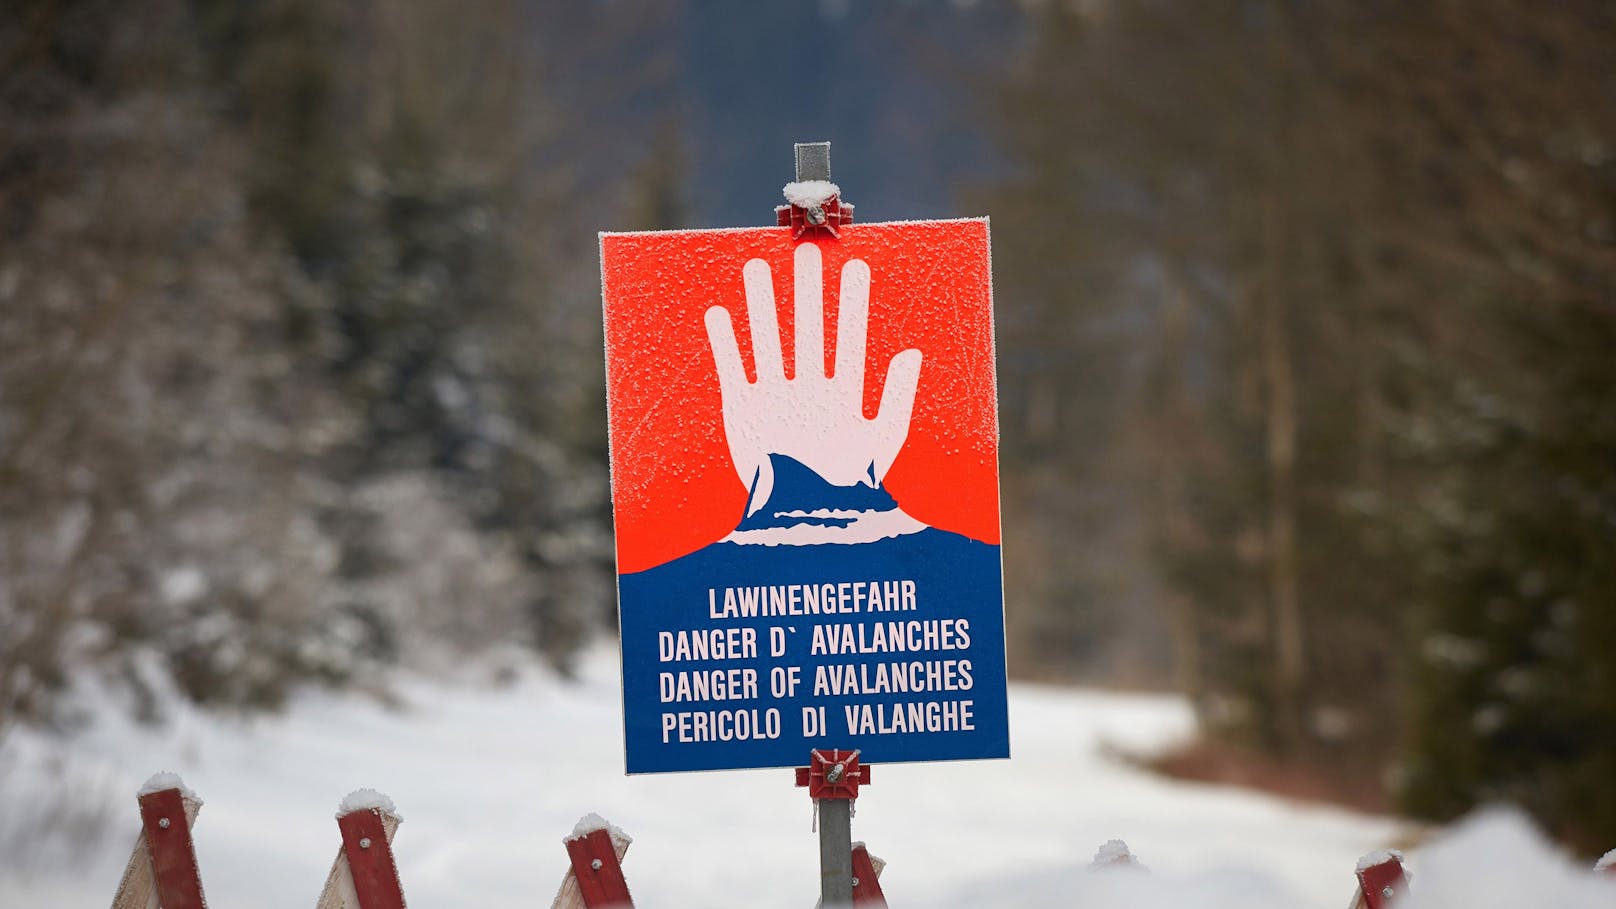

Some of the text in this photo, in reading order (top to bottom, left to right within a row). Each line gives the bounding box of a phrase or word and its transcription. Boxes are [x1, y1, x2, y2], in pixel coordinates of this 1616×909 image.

[709, 580, 917, 619] LAWINENGEFAHR
[658, 628, 757, 662] DANGER
[811, 619, 971, 655] AVALANCHES
[659, 660, 974, 703] DANGER OF AVALANCHES
[662, 700, 975, 743] PERICOLO DI VALANGHE
